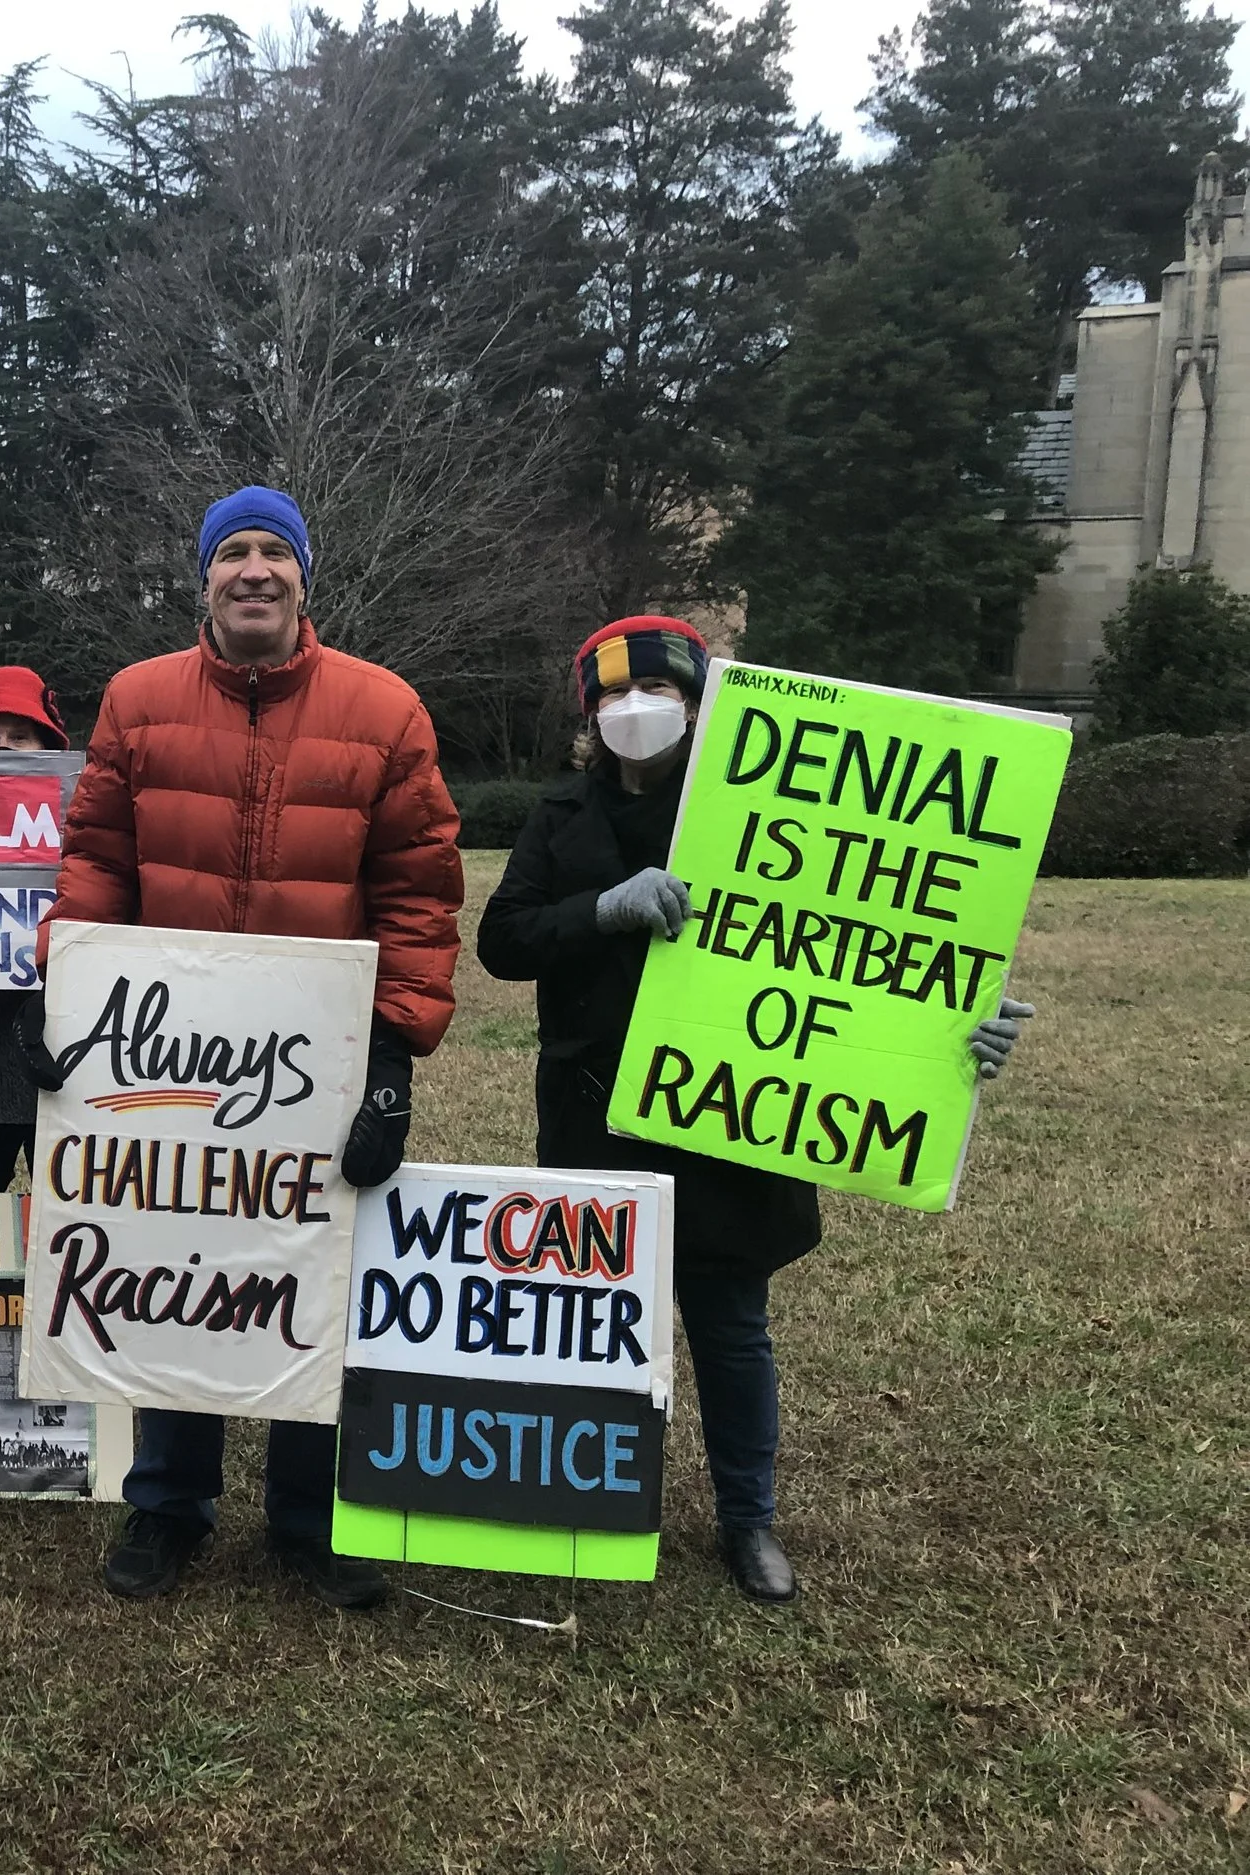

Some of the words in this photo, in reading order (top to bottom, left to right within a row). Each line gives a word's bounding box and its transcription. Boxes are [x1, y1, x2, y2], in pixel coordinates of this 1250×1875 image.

[726, 669, 770, 691] IBRAM
[725, 706, 1021, 851] DENIAL
[734, 811, 807, 881] IS
[824, 827, 980, 923] THE
[666, 881, 1006, 1013] HEARTBEAT
[54, 975, 316, 1130] Always
[745, 986, 854, 1060] OF
[636, 1044, 929, 1187] RACISM
[49, 1134, 333, 1225] CHALLENGE
[385, 1187, 489, 1265] WE
[483, 1191, 638, 1281] CAN
[47, 1222, 319, 1353] Racism
[358, 1268, 443, 1344] DO
[454, 1274, 650, 1367] BETTER
[367, 1402, 641, 1493] JUSTICE
